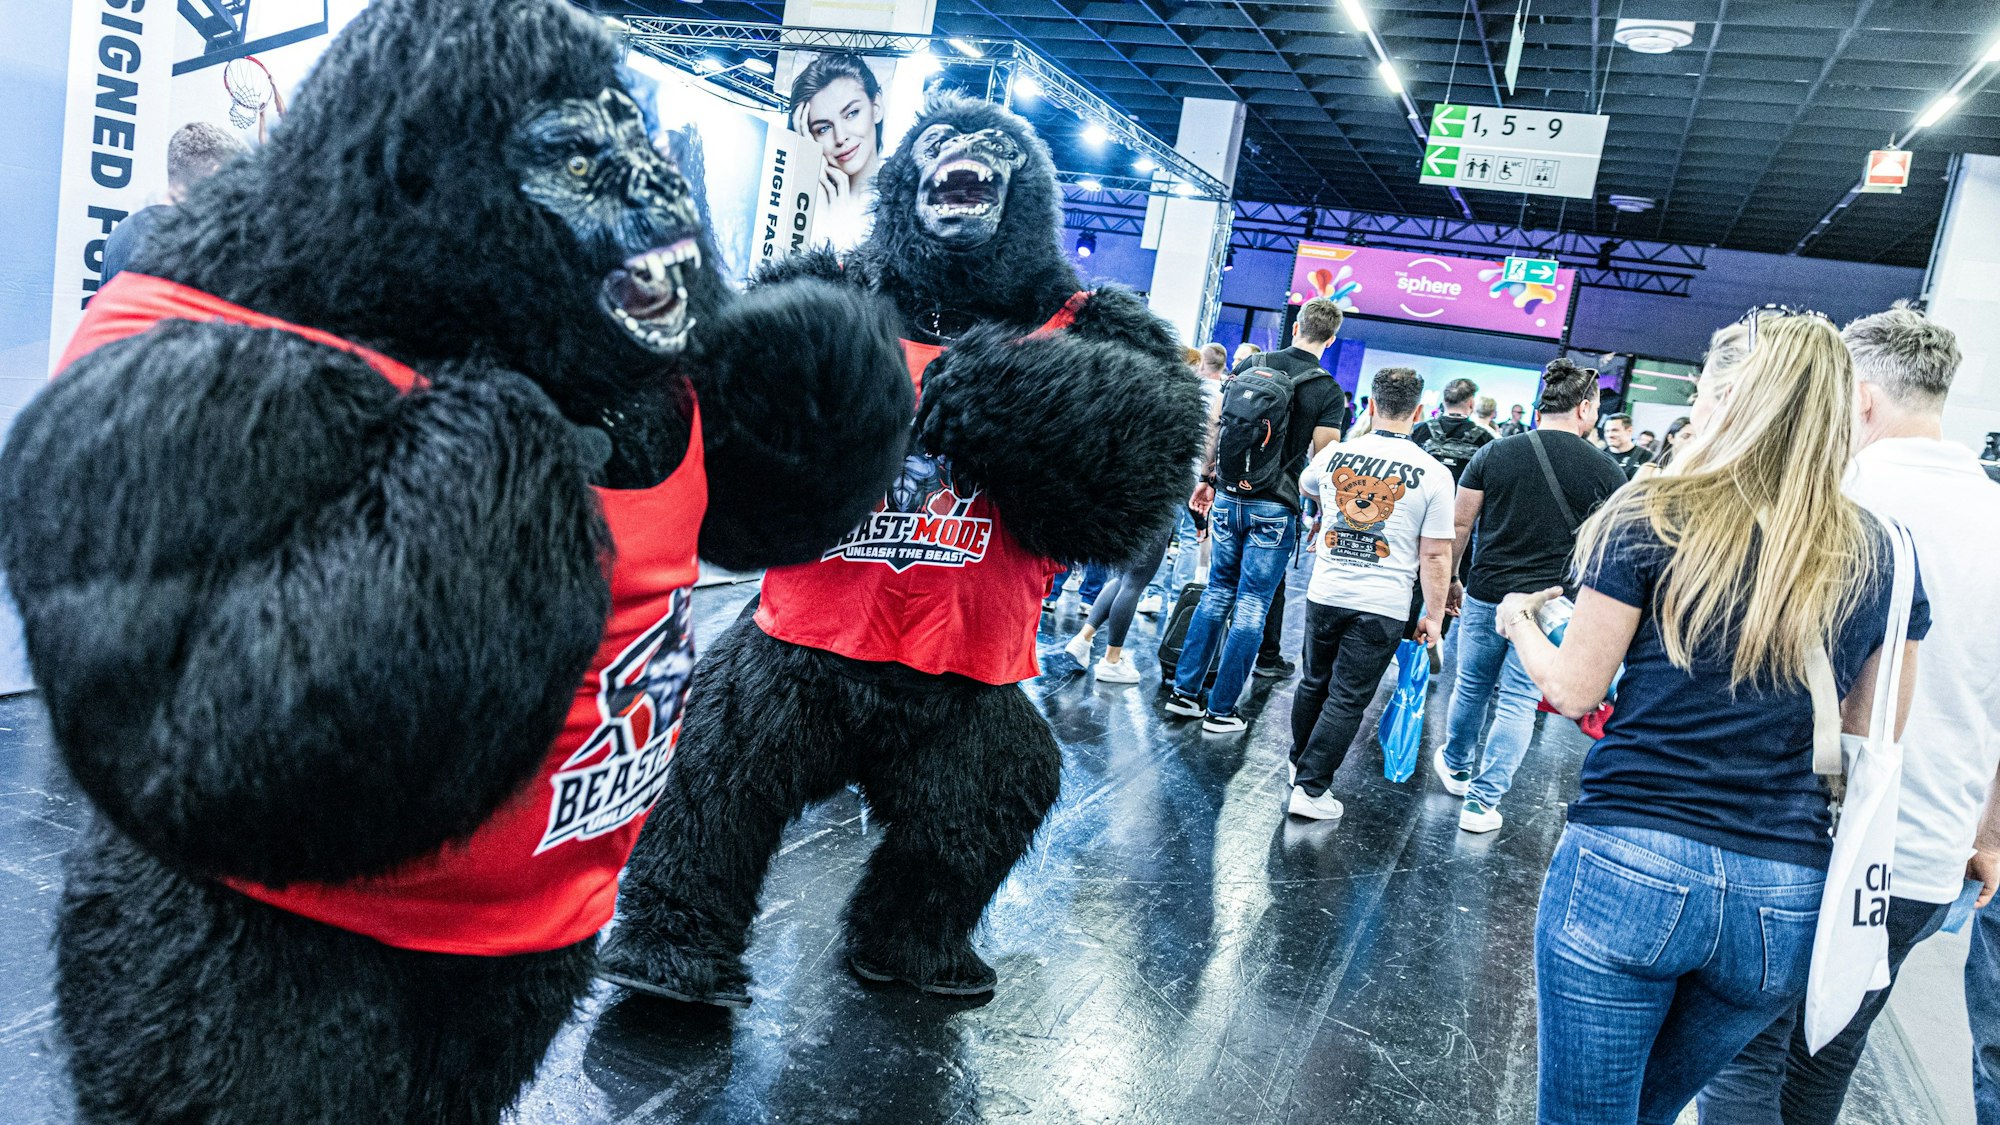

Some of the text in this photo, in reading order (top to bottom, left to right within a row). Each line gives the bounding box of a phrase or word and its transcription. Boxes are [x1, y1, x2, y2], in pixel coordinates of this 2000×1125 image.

[1472, 113, 1488, 137] 1,
[1501, 115, 1517, 136] 5
[1548, 118, 1563, 139] 9
[769, 149, 787, 207] HIGH
[1397, 275, 1462, 295] sphere
[1325, 451, 1426, 490] RECKLESS
[845, 545, 967, 562] UNLEASH THE BEAST
[912, 516, 991, 555] MODE
[551, 735, 667, 834] BEAST
